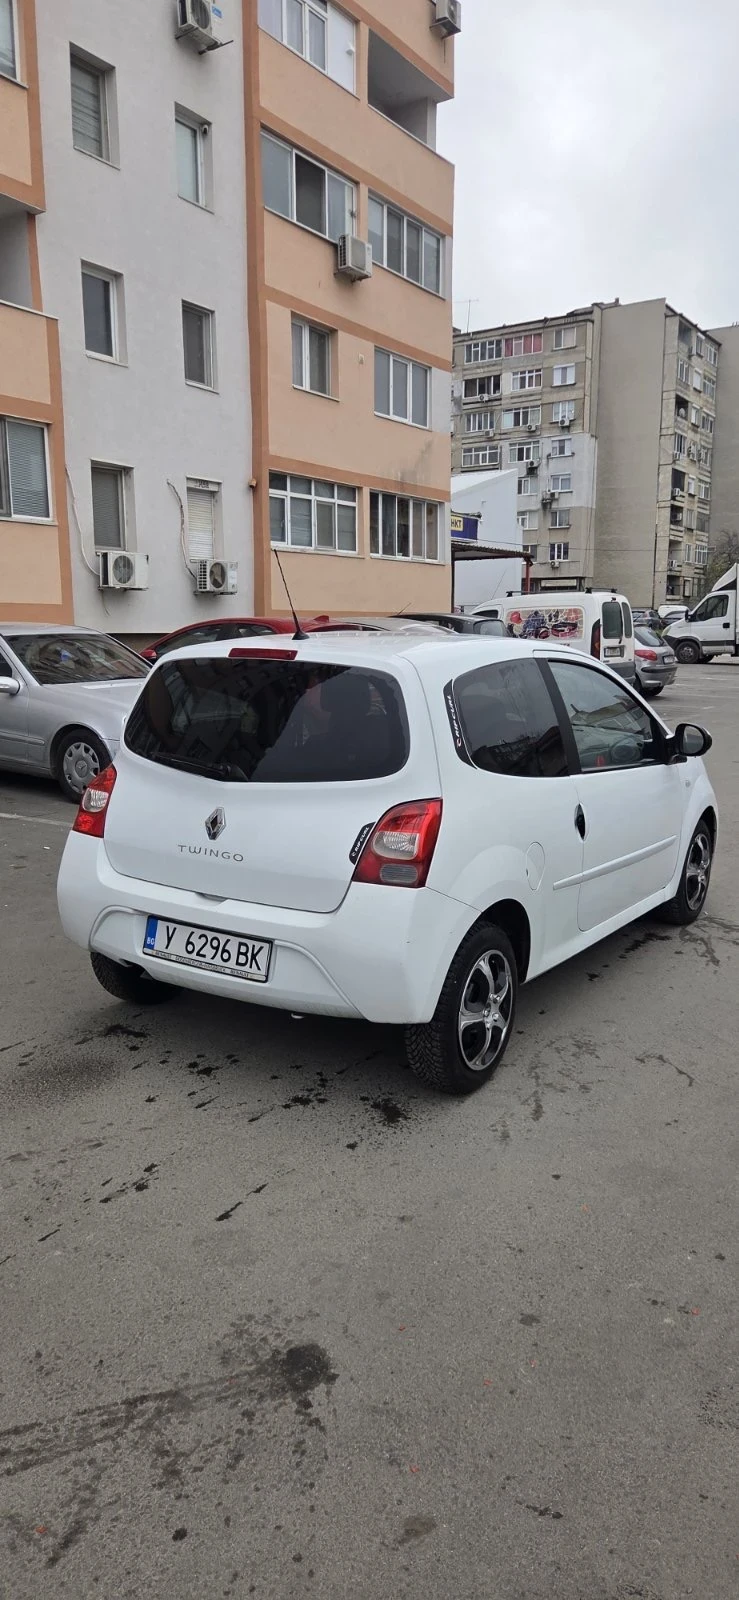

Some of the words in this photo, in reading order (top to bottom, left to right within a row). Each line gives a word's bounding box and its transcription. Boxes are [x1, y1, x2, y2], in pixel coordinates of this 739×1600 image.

[177, 844, 244, 862] TWINGO
[146, 937, 155, 946] BG
[185, 931, 232, 963] 6296
[235, 941, 264, 971] BK
